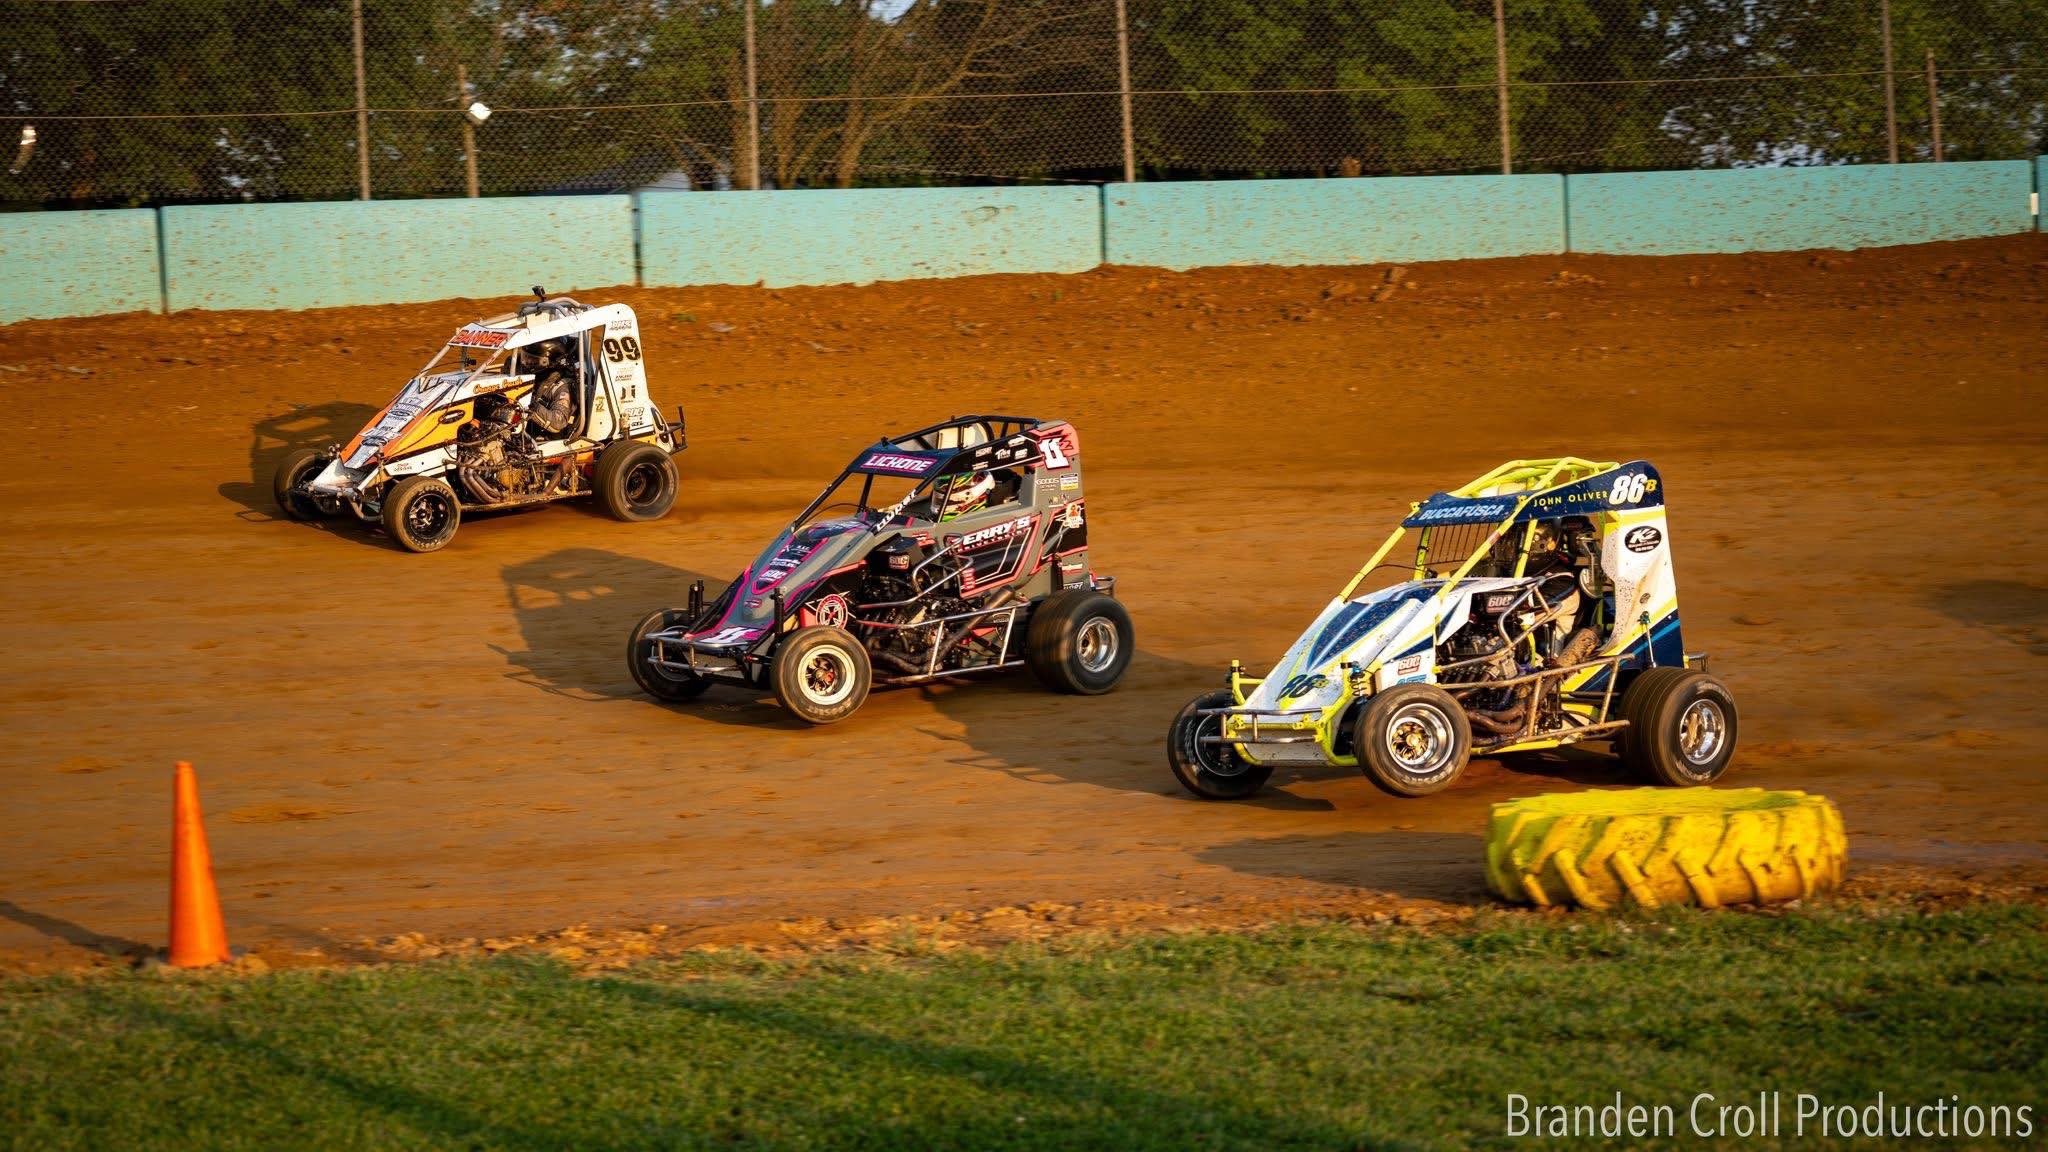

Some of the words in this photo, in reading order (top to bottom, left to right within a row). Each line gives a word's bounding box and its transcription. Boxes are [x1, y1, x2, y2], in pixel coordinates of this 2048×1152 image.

[604, 336, 641, 362] 99
[863, 456, 934, 471] LICKONE
[1608, 473, 1649, 506] 86
[1533, 496, 1562, 508] JOHN
[1568, 491, 1609, 503] OLIVER
[1418, 504, 1505, 521] BUCCAFUSCA
[1630, 528, 1657, 544] K2
